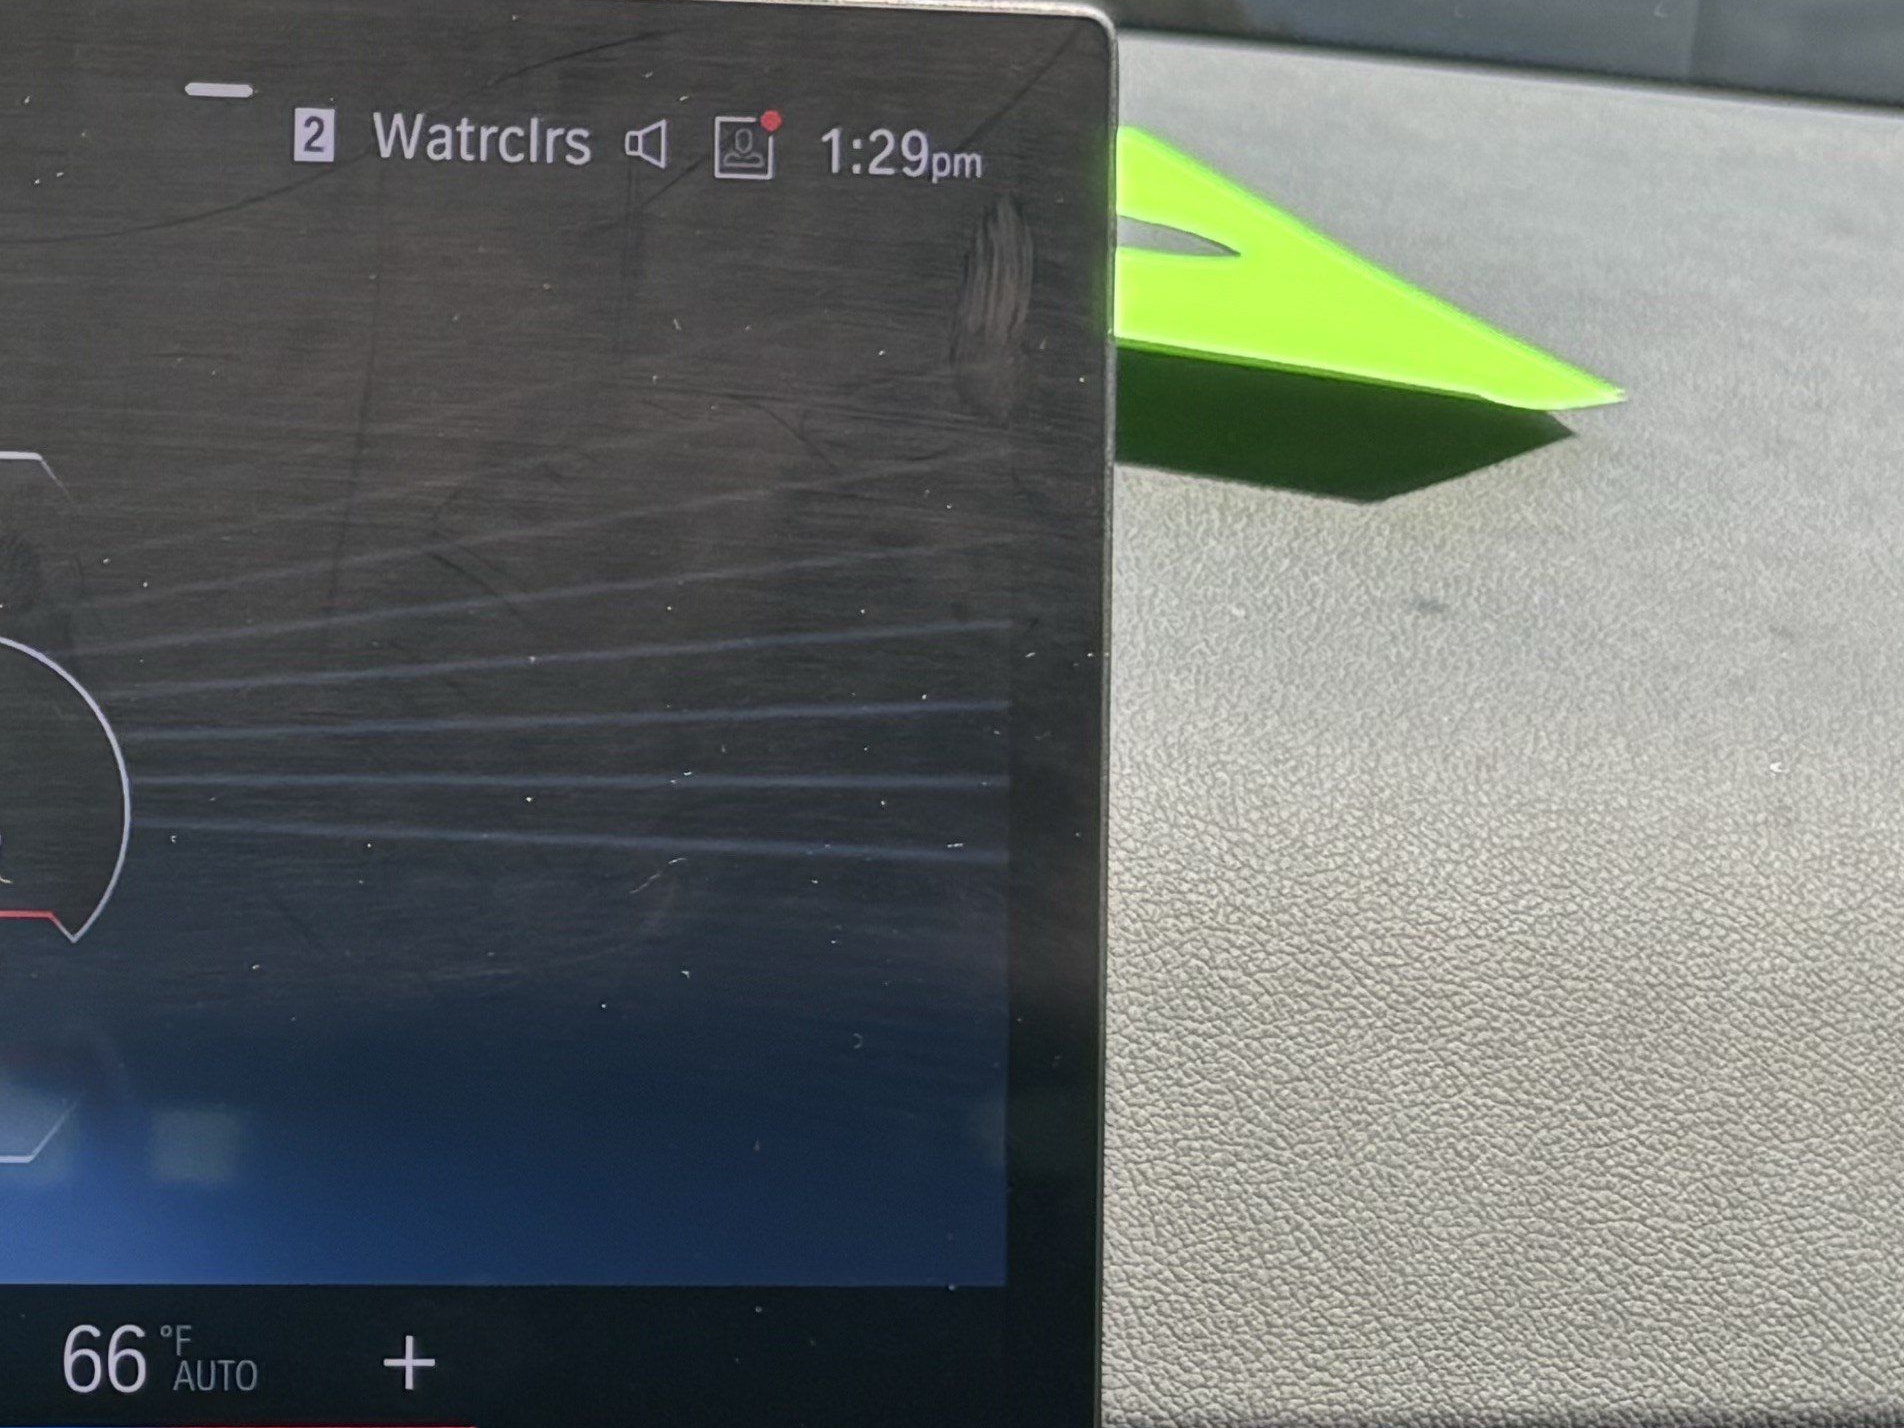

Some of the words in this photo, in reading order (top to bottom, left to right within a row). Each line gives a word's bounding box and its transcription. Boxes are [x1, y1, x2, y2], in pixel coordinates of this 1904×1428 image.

[302, 116, 326, 154] 2
[373, 111, 593, 167] Watrclrs
[821, 127, 984, 183] 1:29pm
[62, 1323, 147, 1394] 66
[173, 1360, 258, 1393] AUTO
